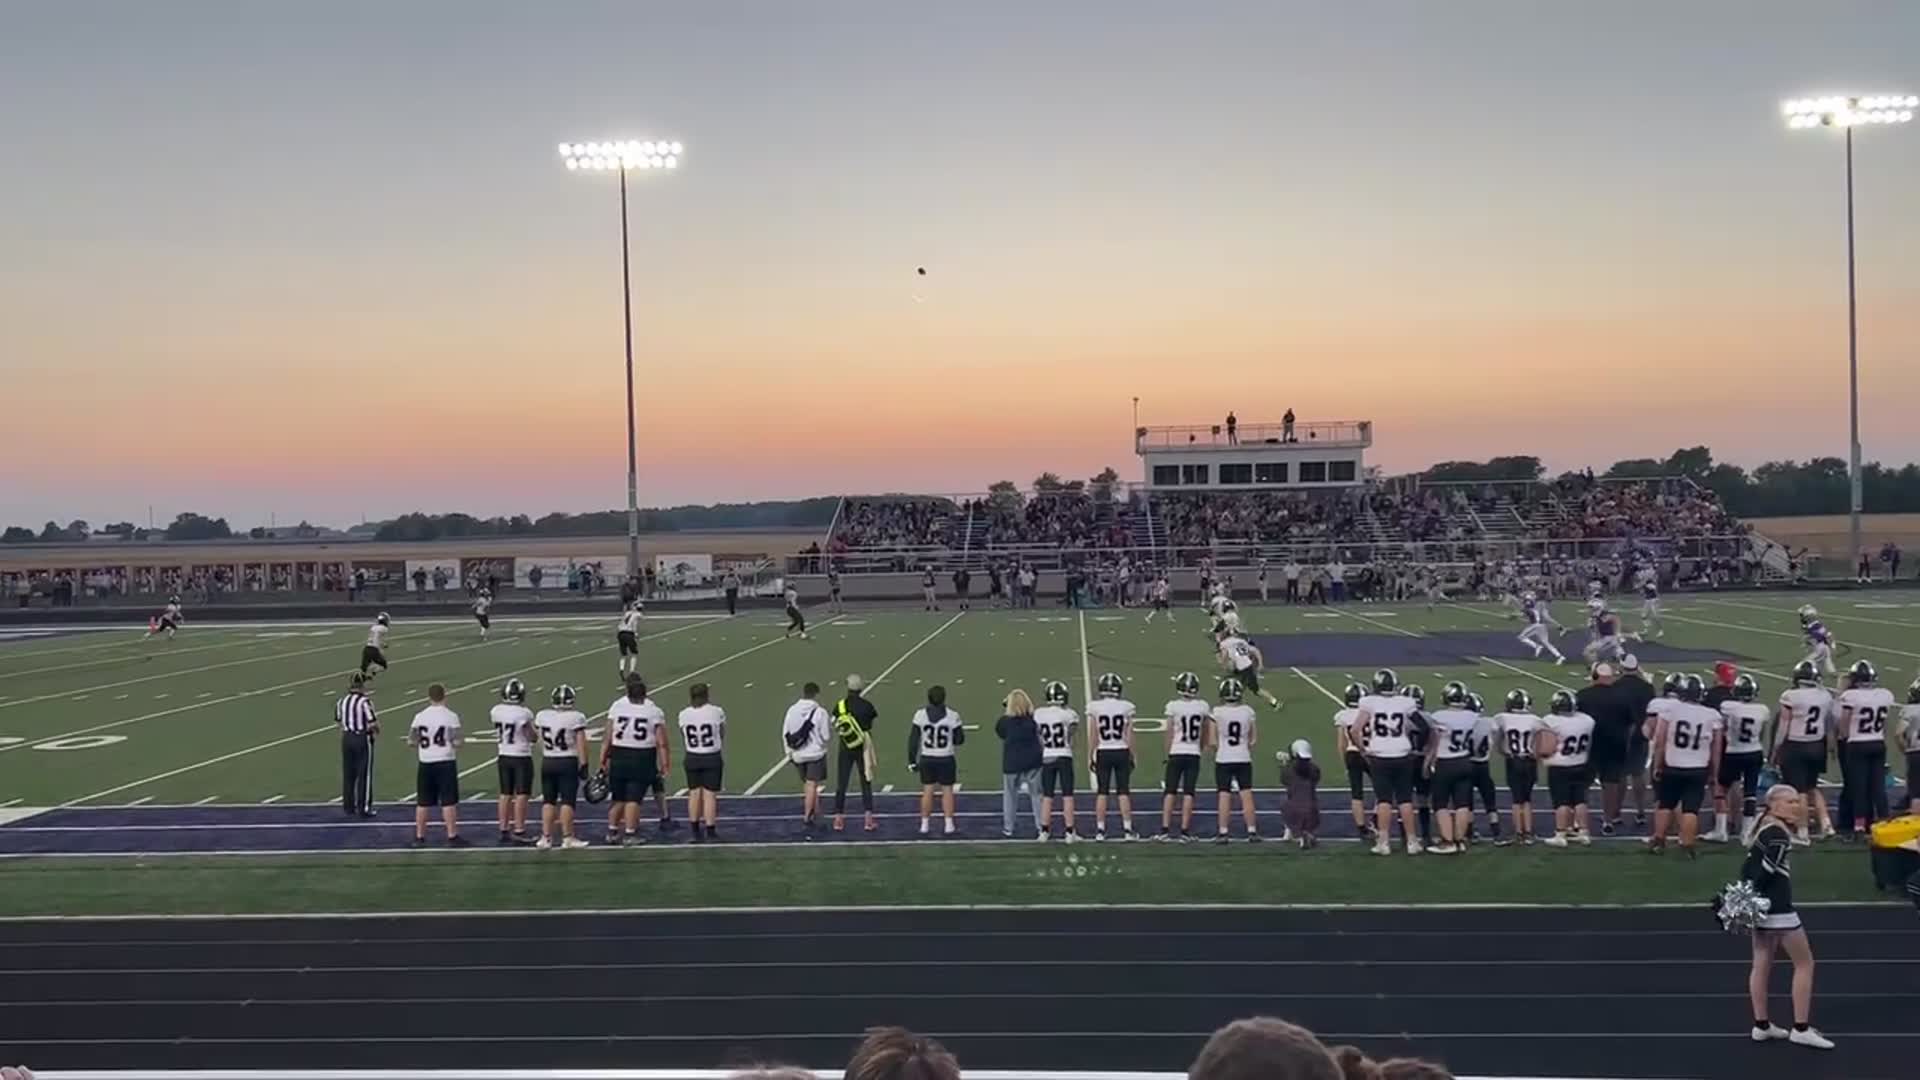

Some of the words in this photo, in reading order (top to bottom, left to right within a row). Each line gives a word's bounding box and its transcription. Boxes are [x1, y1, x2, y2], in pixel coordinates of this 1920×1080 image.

[616, 717, 648, 740] 75
[1099, 715, 1124, 740] 29
[1181, 715, 1201, 741] 16
[1374, 712, 1404, 738] 63
[1739, 718, 1755, 743] 5
[1805, 706, 1821, 735] 2
[1858, 707, 1887, 733] 26
[418, 726, 446, 749] 64
[542, 726, 568, 750] 54
[686, 724, 714, 747] 62
[924, 725, 949, 749] 36
[1040, 722, 1066, 748] 22
[1228, 721, 1241, 746] 9
[1674, 720, 1703, 750] 61
